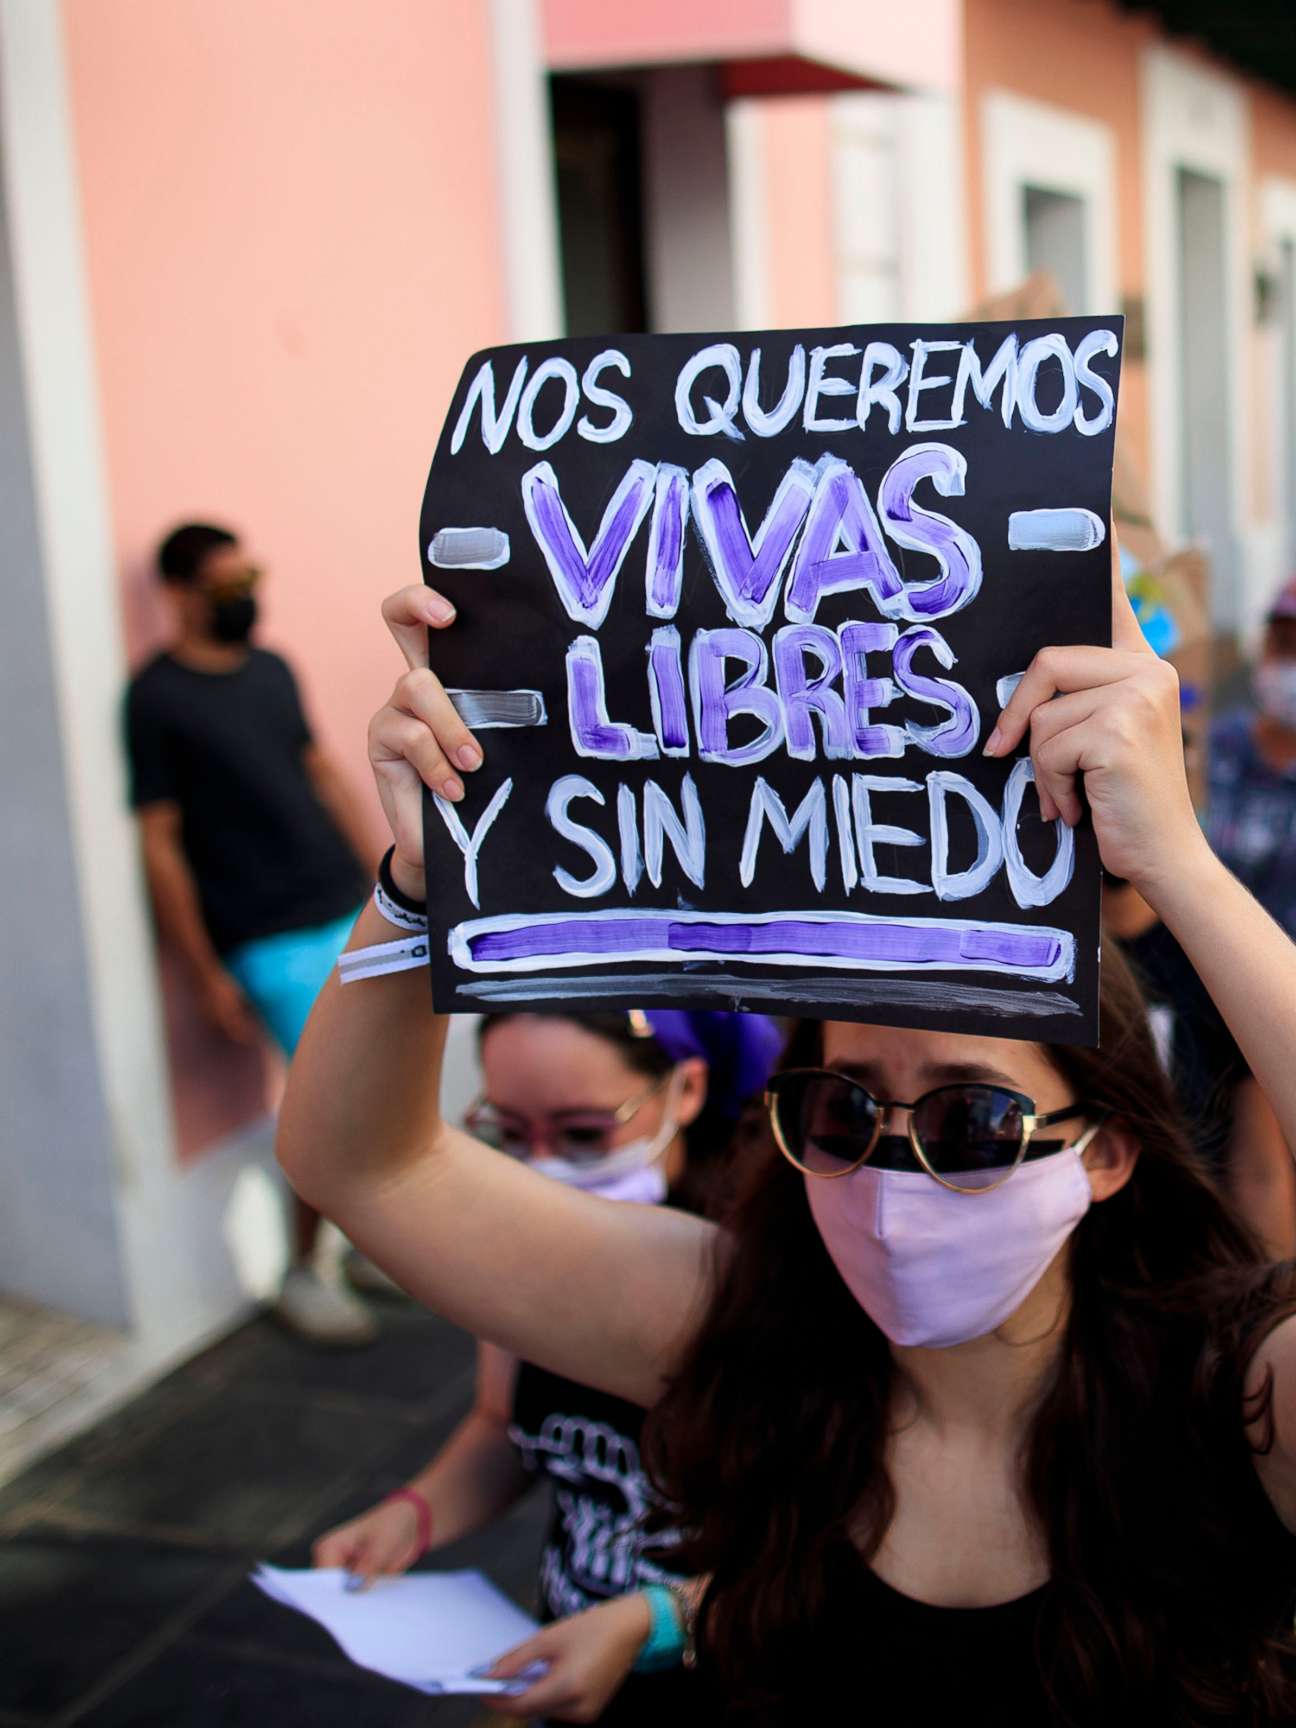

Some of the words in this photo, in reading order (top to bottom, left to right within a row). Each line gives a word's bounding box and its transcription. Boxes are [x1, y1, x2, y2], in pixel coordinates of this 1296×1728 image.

[451, 349, 633, 455] NOS
[674, 330, 1118, 441] QUEREMOS
[521, 442, 984, 630] VIVAS
[566, 621, 980, 766] LIBRES
[434, 777, 512, 910] Y
[546, 770, 706, 897] SIN
[740, 758, 1074, 908] MIEDO
